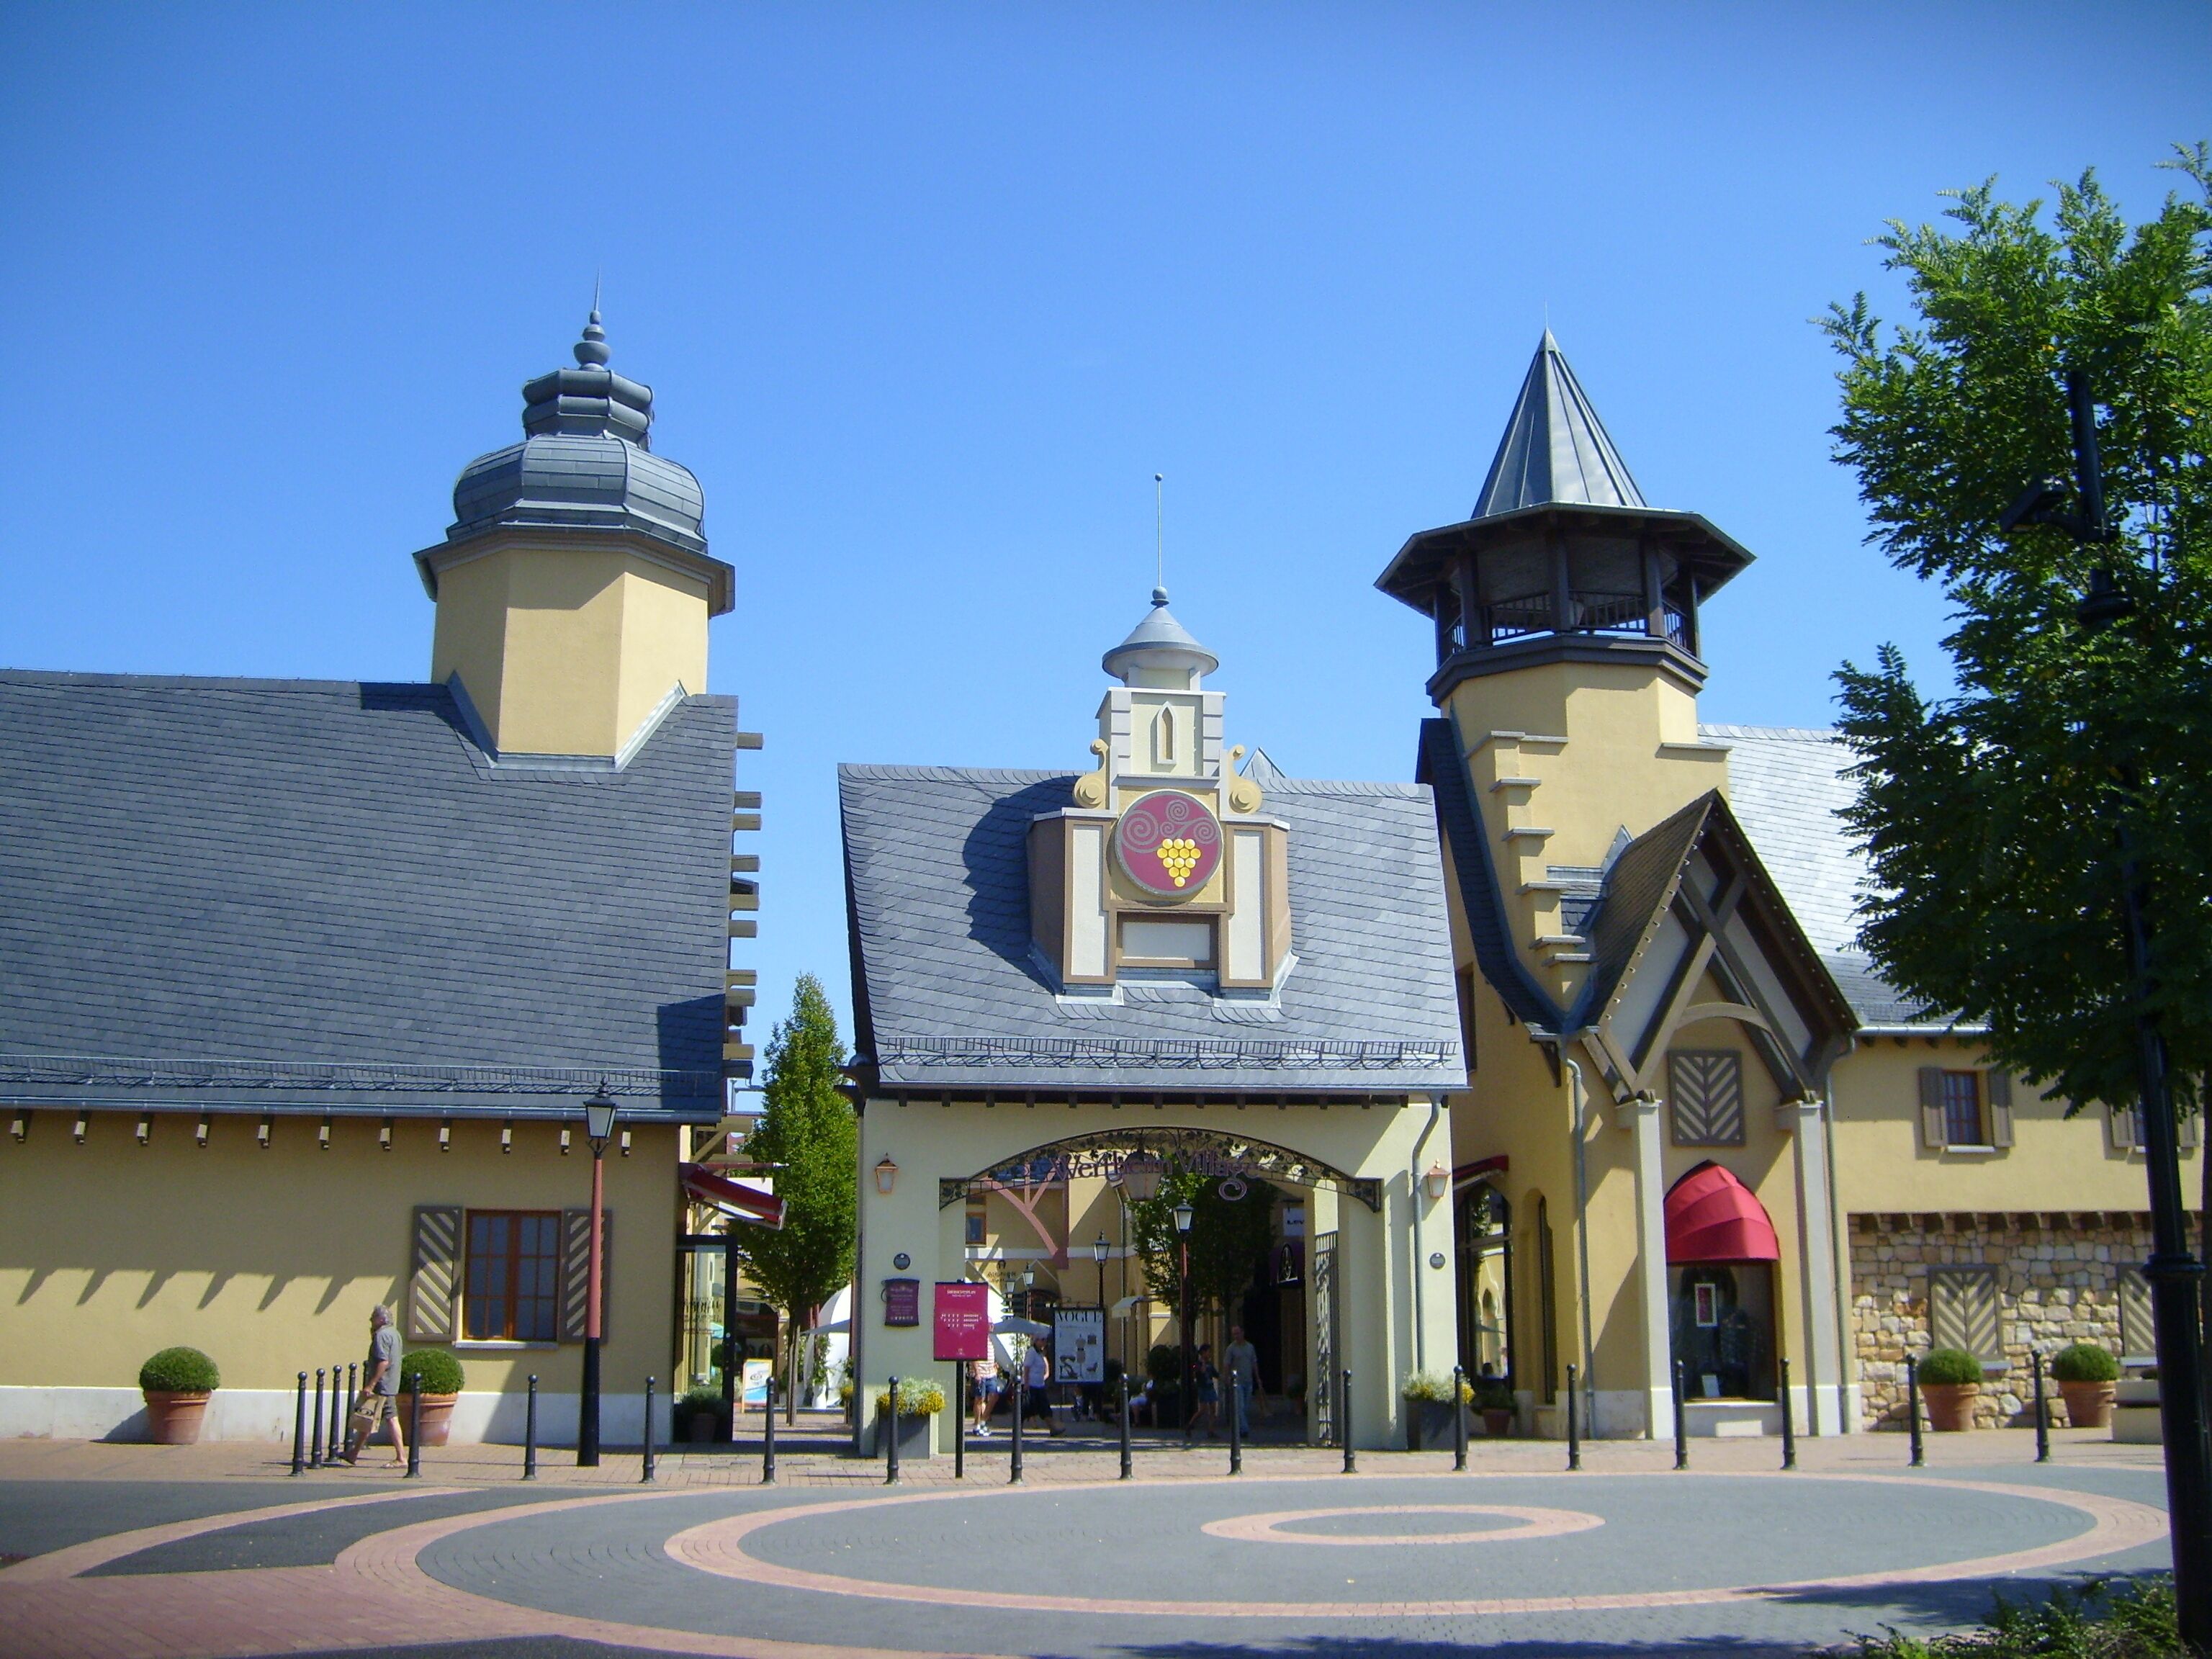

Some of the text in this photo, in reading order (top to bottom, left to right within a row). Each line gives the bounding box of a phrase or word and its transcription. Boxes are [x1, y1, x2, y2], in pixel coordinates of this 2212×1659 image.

[1048, 1150, 1260, 1200] Wertheim Village
[1056, 1310, 1102, 1323] VOGUE
